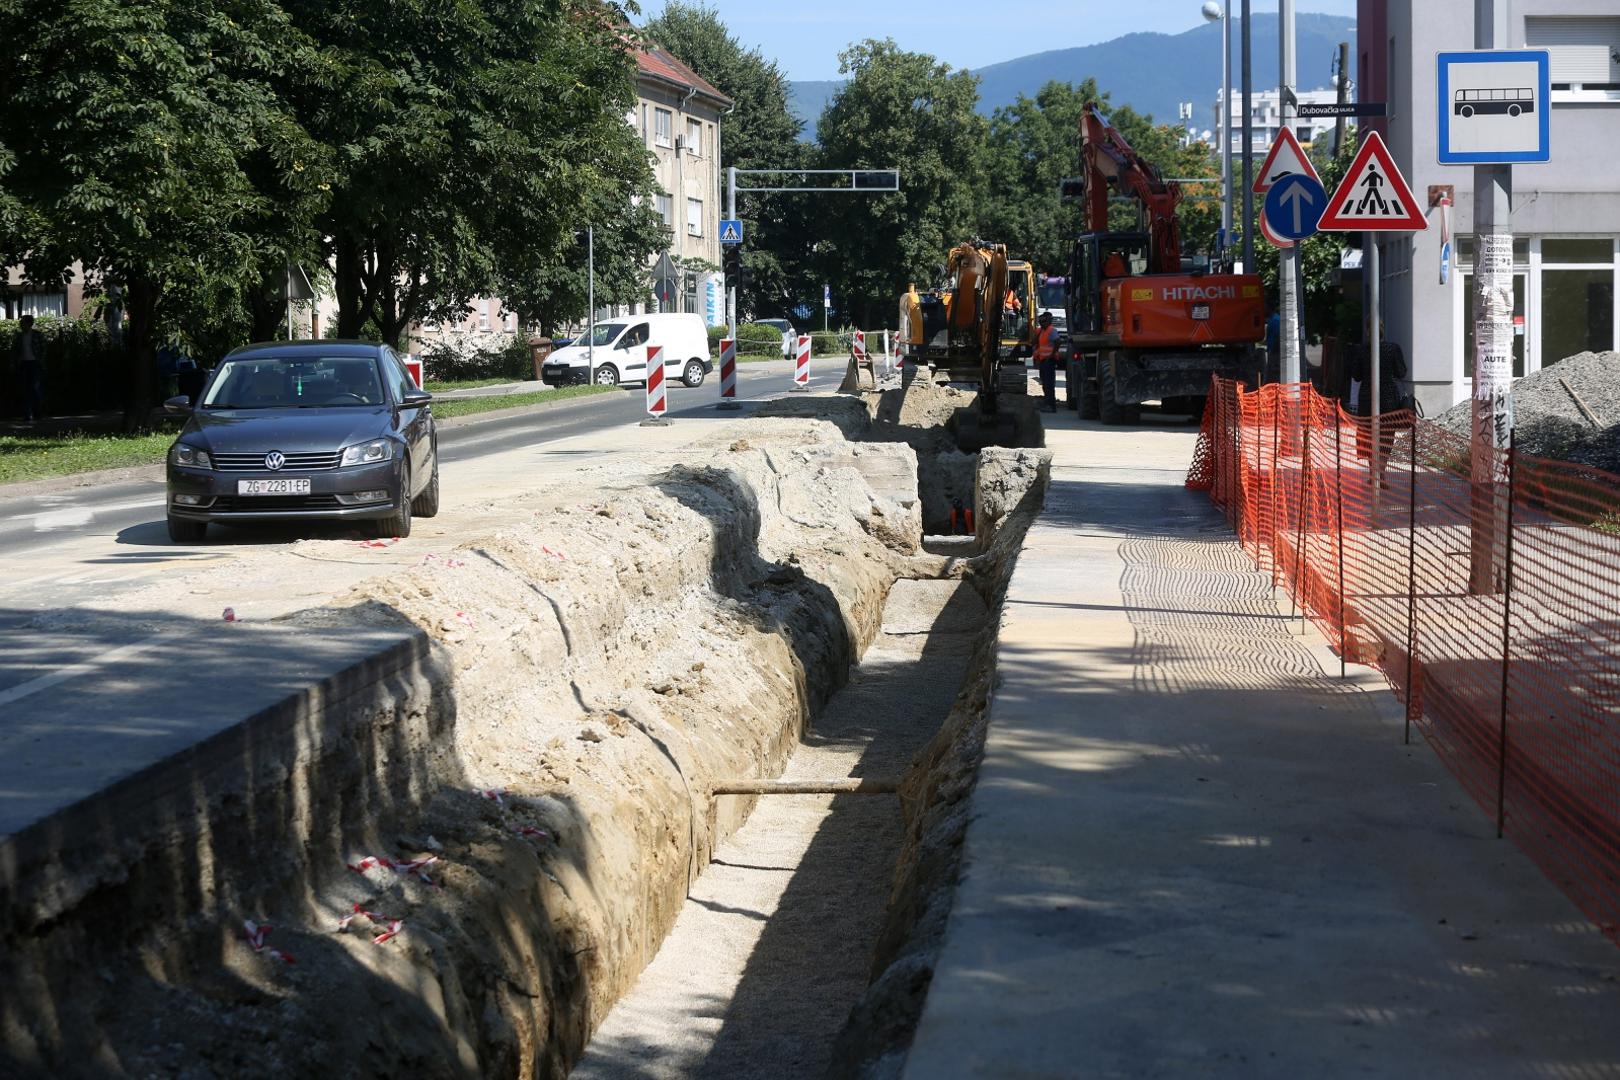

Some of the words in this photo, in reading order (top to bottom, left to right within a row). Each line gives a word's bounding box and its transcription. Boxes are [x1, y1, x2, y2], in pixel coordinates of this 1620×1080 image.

[1301, 106, 1339, 115] Dubovačka
[1162, 286, 1236, 301] HITACHI
[1483, 355, 1507, 363] AUTE
[247, 481, 260, 492] ZG
